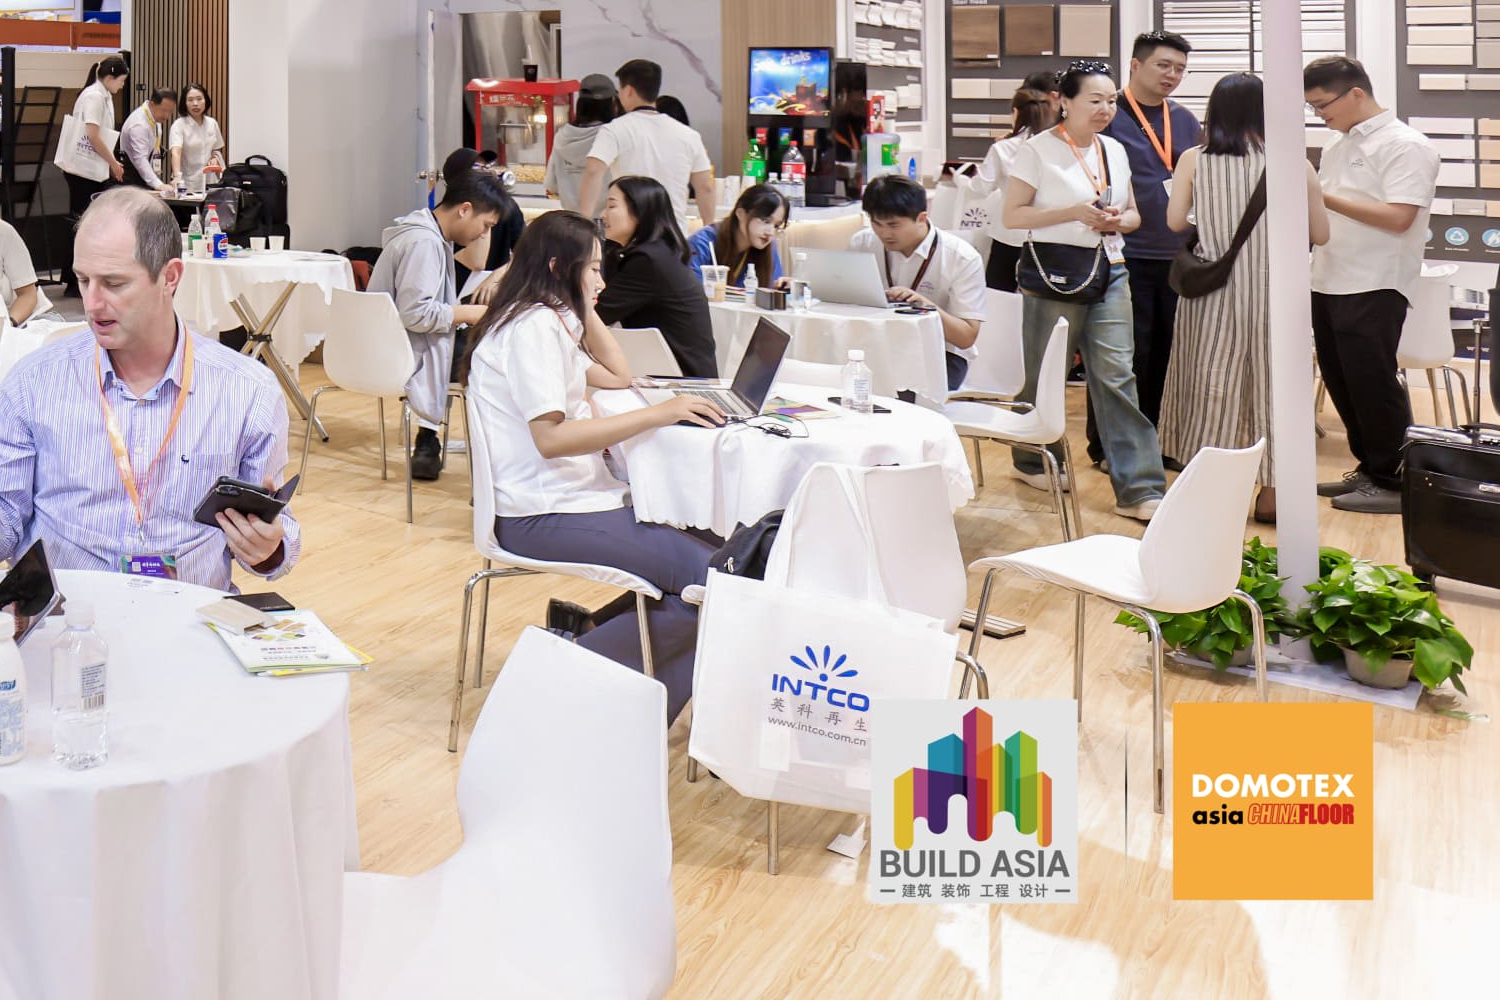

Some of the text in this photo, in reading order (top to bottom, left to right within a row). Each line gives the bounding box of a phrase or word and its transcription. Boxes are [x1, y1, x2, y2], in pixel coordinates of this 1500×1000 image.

[780, 50, 812, 66] drinks
[771, 673, 870, 712] INTCO
[767, 716, 867, 747] www.intco.com.cn
[770, 697, 868, 733] 英科再生
